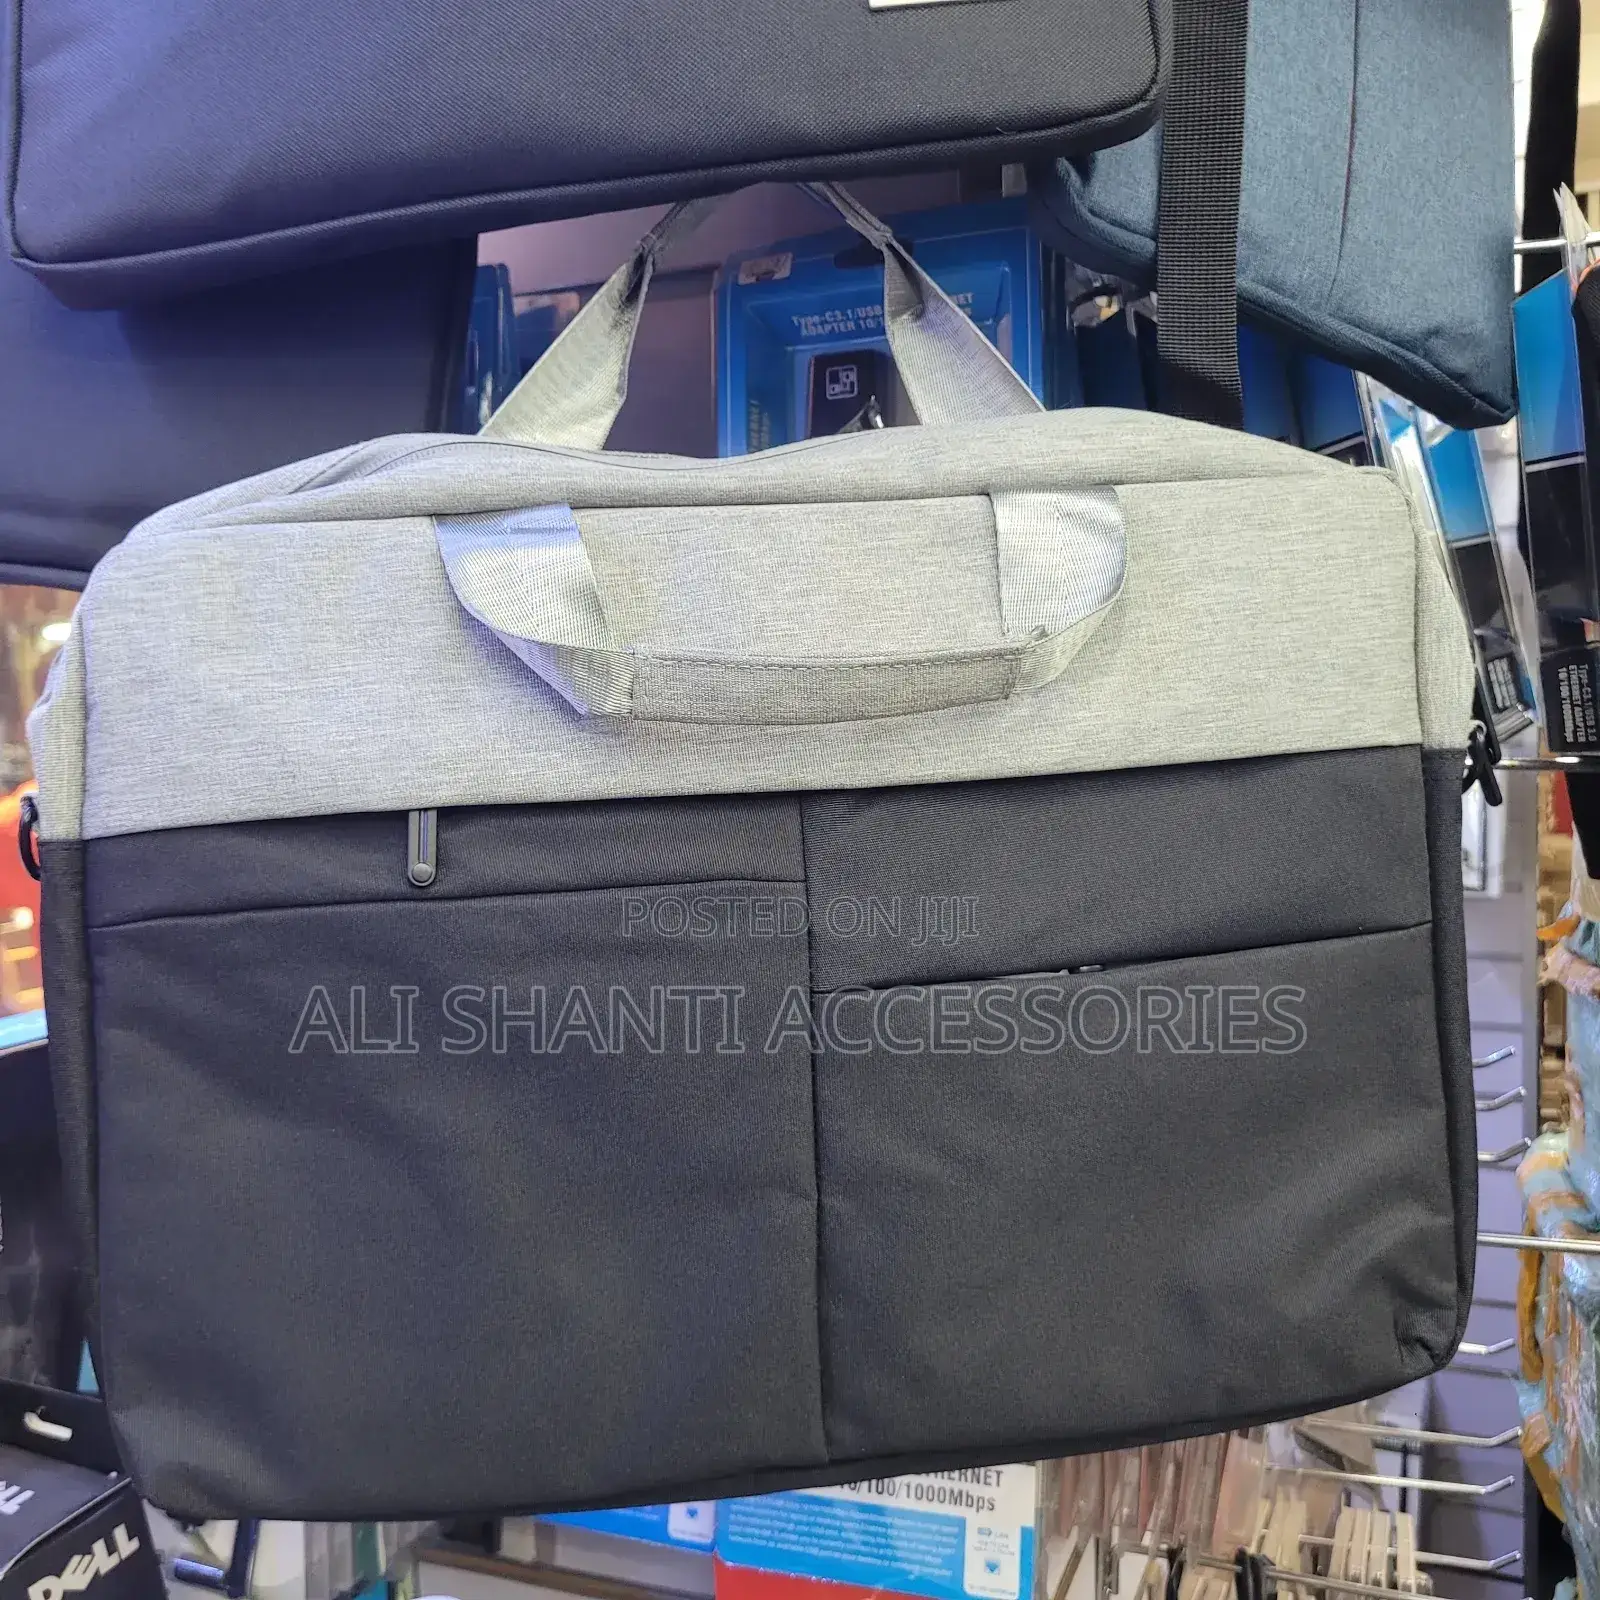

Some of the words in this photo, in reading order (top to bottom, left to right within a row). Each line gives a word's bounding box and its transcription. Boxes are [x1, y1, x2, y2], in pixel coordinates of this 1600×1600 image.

[801, 320, 856, 336] ADAPTER
[1568, 664, 1582, 705] ETHERNET
[1574, 706, 1586, 742] ADAPTER
